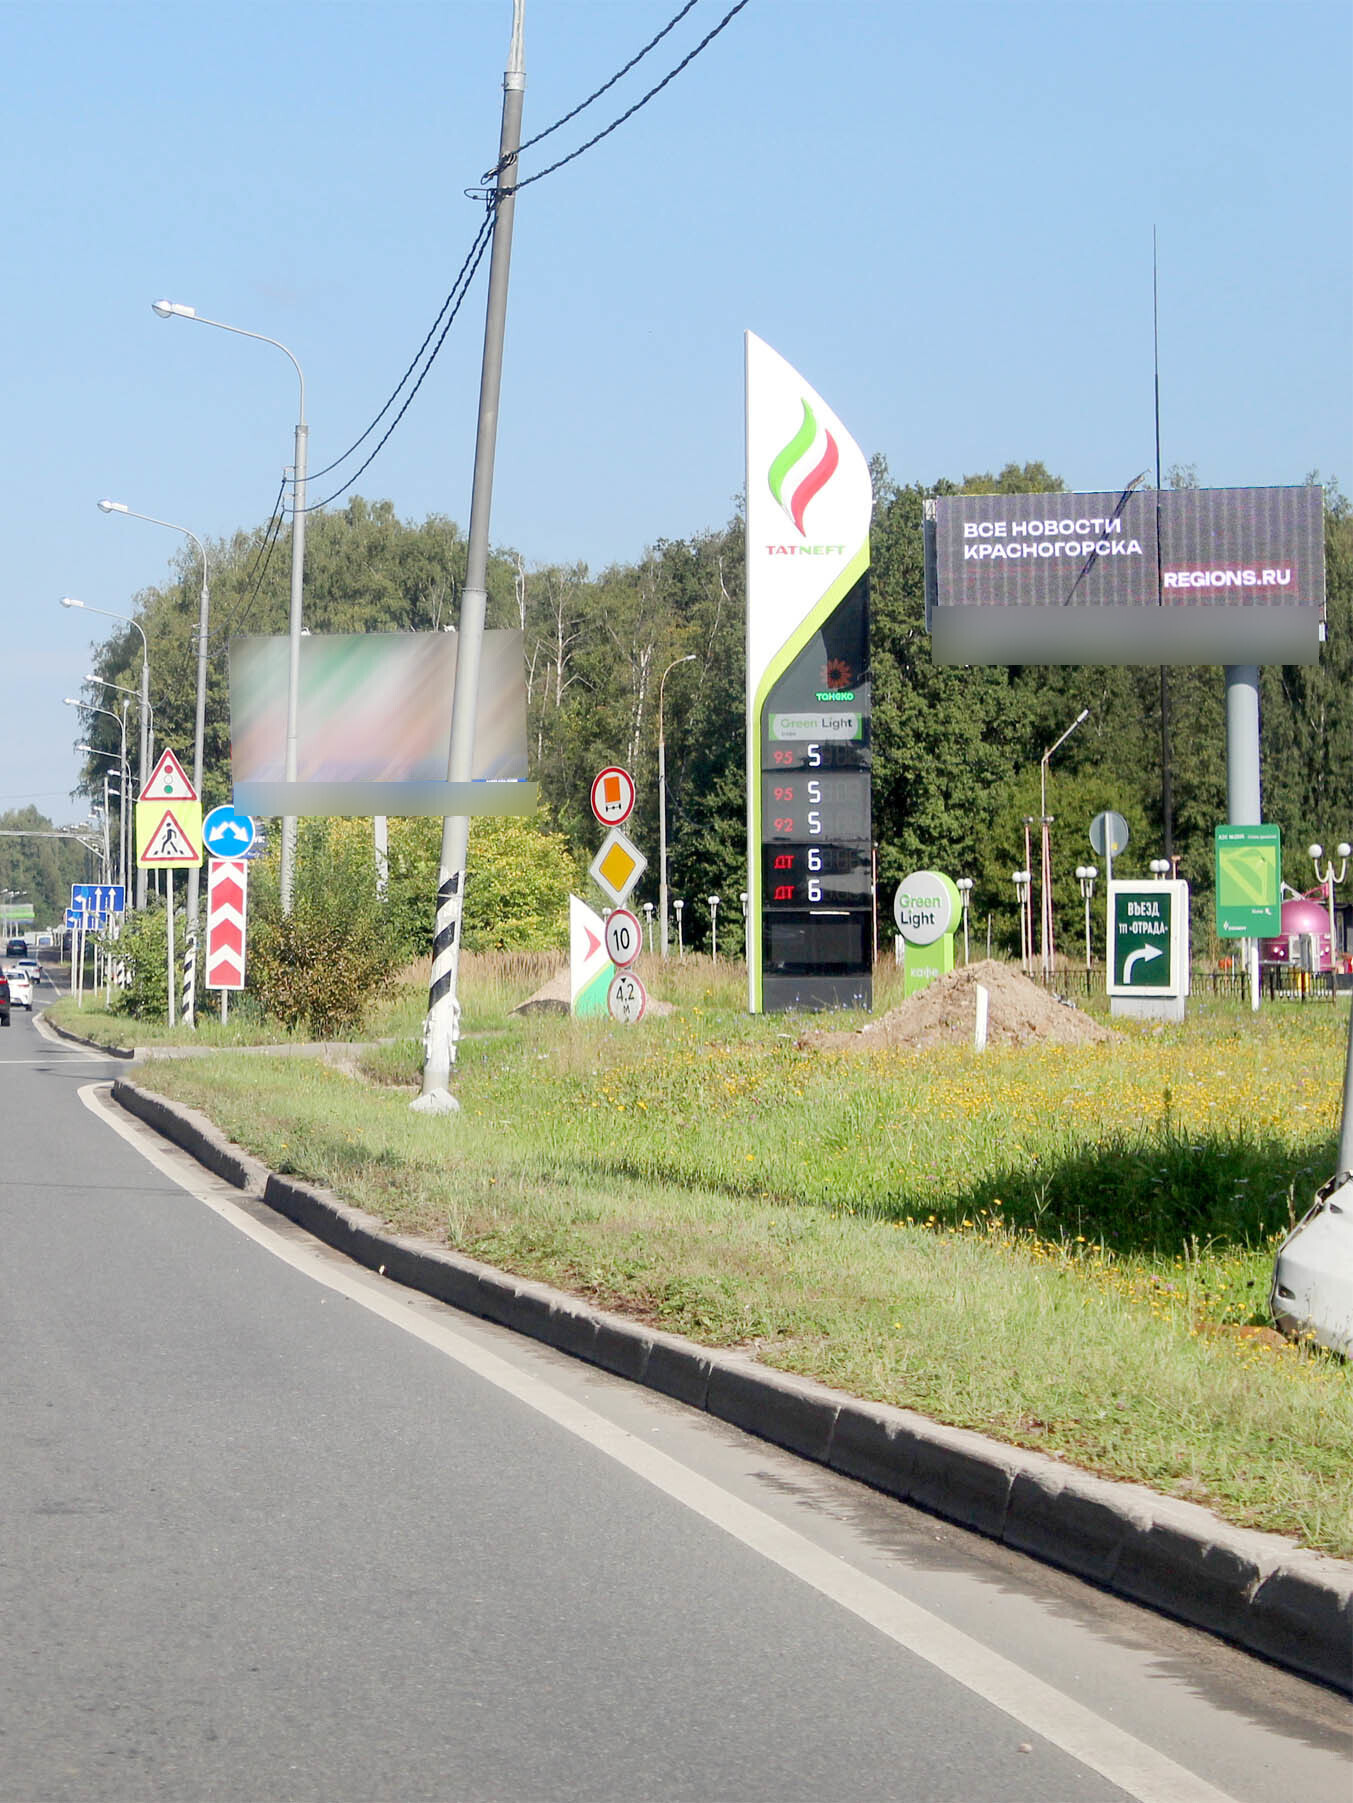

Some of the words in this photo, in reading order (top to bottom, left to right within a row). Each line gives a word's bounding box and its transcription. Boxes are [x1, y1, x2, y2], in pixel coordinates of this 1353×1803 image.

[963, 522, 1007, 539] ВСЕ
[1011, 518, 1122, 537] НОВОСТИ
[765, 545, 846, 555] TATNEFT
[963, 539, 1144, 561] КРАСНОГОРСКА
[1163, 568, 1292, 588] REGIONS.RU
[781, 718, 818, 729] Green
[821, 717, 853, 731] Light
[773, 752, 795, 765] 95
[773, 787, 795, 801] 95
[773, 818, 795, 832] 92
[773, 855, 795, 869] ДТ
[773, 886, 795, 900] ДТ
[899, 894, 941, 909] Green
[1127, 901, 1160, 917] ВЪЕЗД
[900, 911, 936, 929] Light
[613, 927, 631, 951] 10
